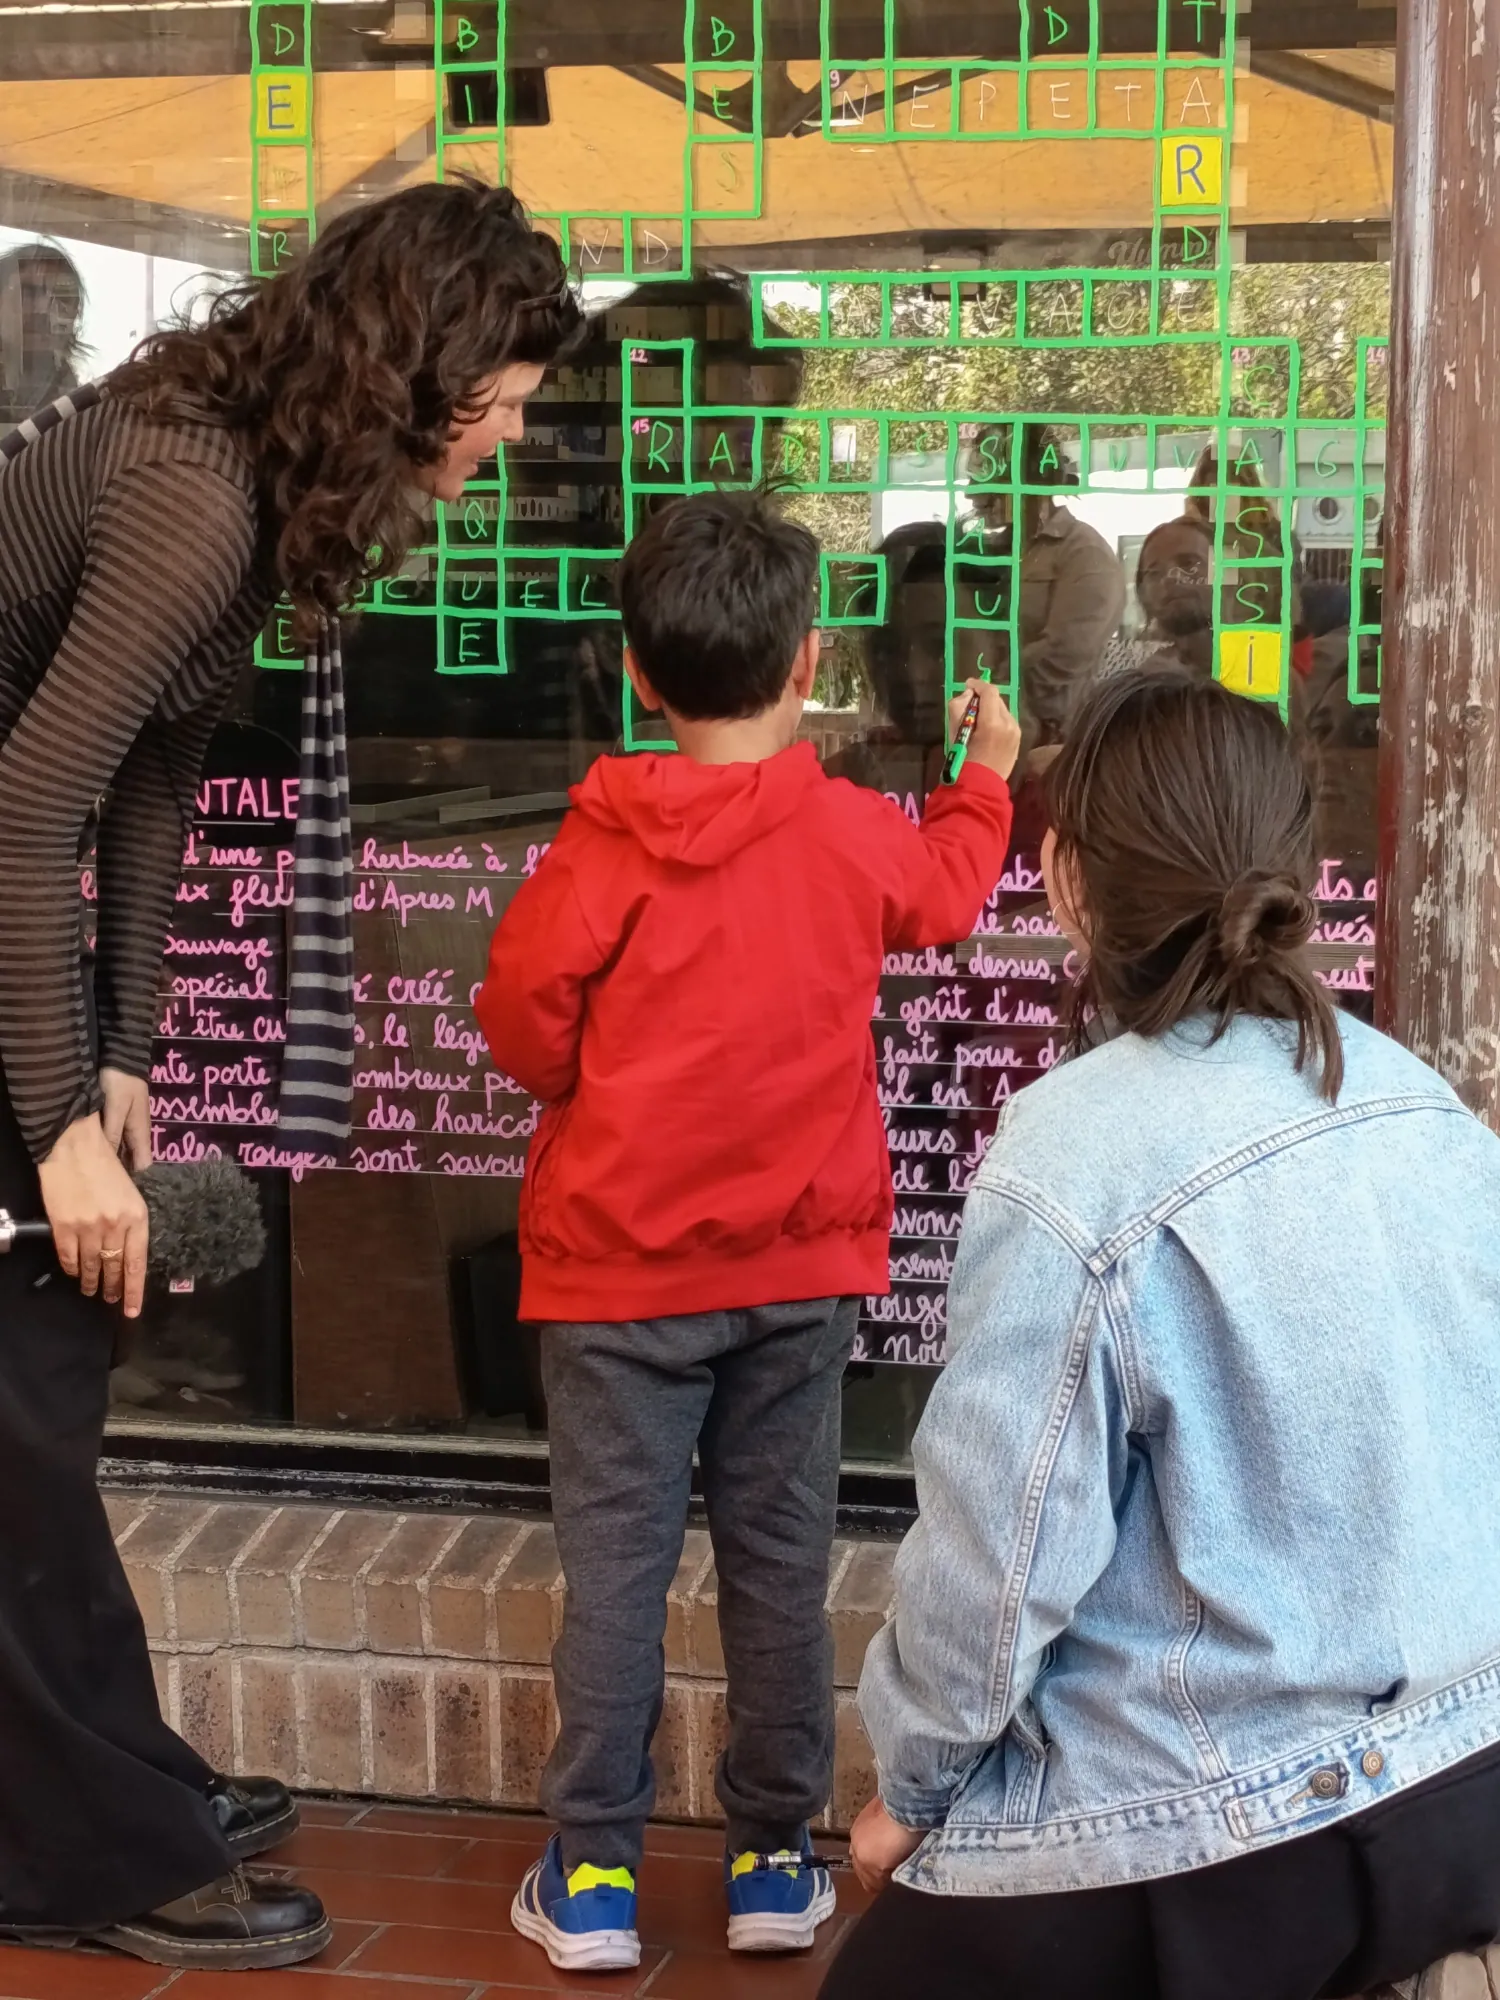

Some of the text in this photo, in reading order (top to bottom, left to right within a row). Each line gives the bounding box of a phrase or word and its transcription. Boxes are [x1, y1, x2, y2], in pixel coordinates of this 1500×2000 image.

[830, 70, 840, 88] 9
[842, 76, 1212, 128] NEPETA
[629, 348, 648, 363] 12
[632, 418, 650, 434] 15
[353, 1055, 471, 1092] ombreux
